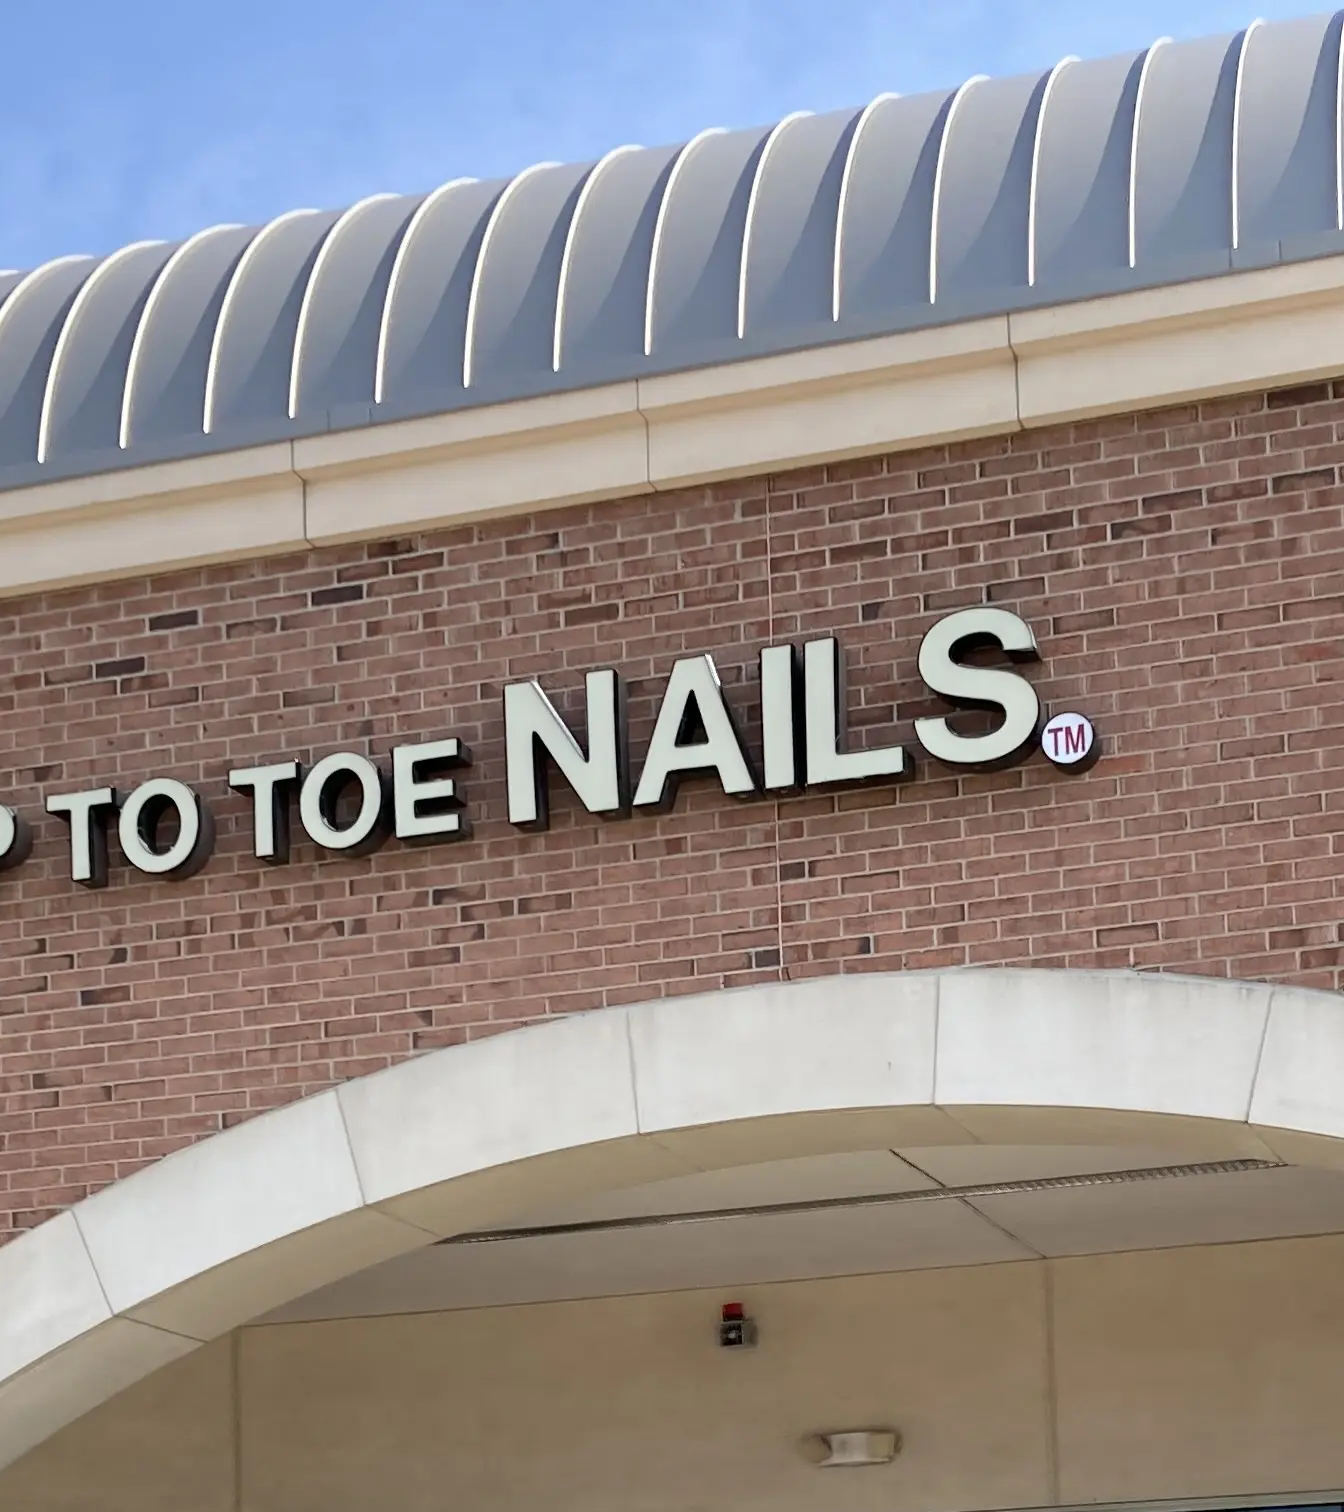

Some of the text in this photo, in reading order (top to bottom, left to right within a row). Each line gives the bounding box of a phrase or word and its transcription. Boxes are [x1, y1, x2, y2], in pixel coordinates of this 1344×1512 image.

[46, 777, 202, 883] TO
[228, 737, 460, 862] TOE
[502, 606, 1042, 826] NAILS
[1047, 723, 1086, 757] TM
